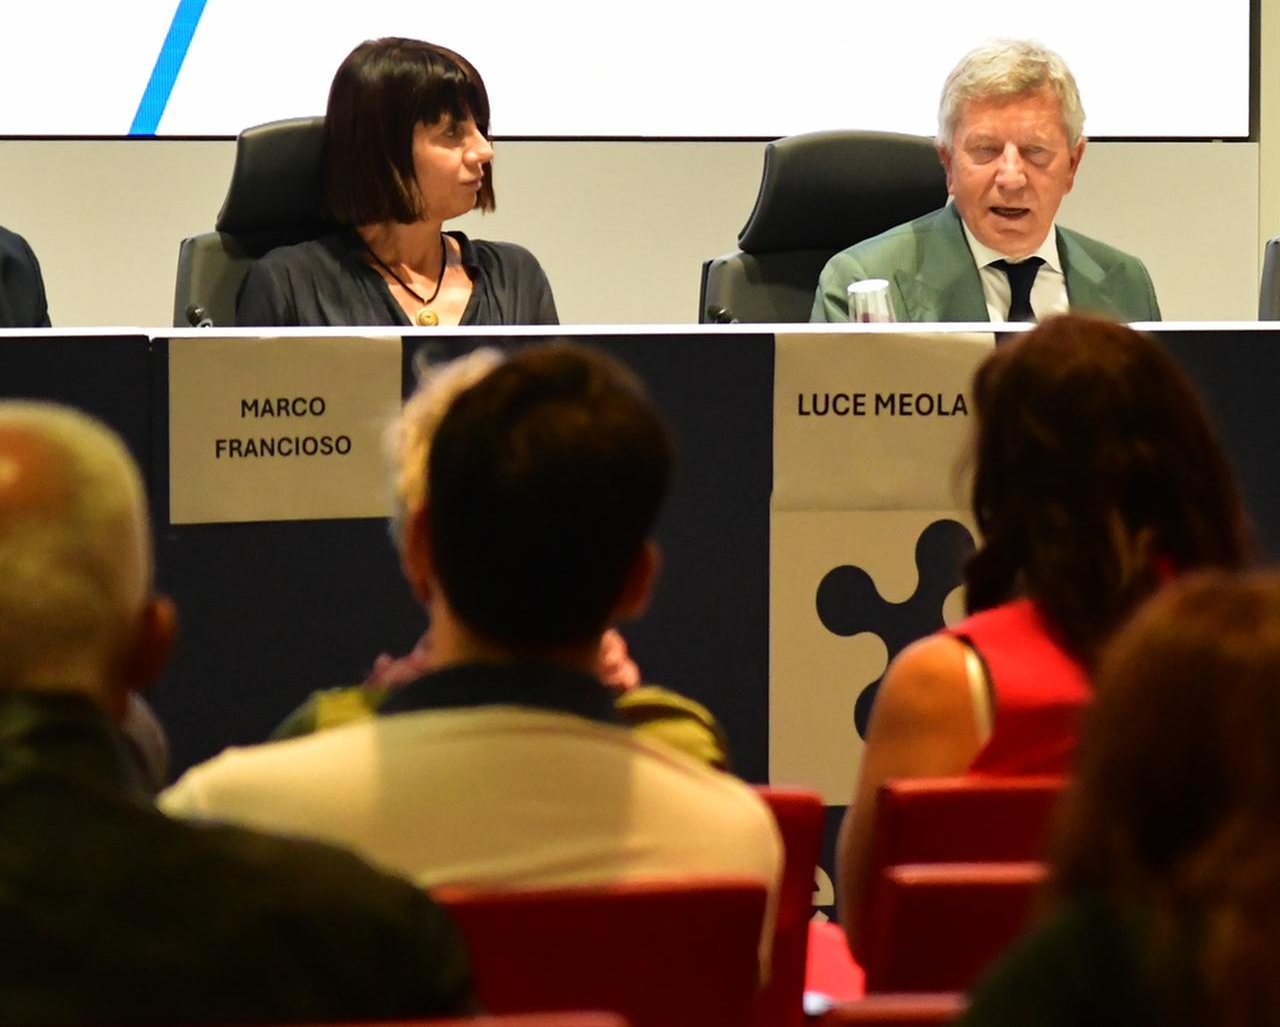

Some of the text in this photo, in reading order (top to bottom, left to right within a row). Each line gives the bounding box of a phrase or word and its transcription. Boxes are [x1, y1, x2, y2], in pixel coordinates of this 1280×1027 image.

[240, 396, 326, 419] MARCO
[797, 392, 969, 417] LUCE MEOLA
[215, 434, 352, 459] FRANCIOSO
